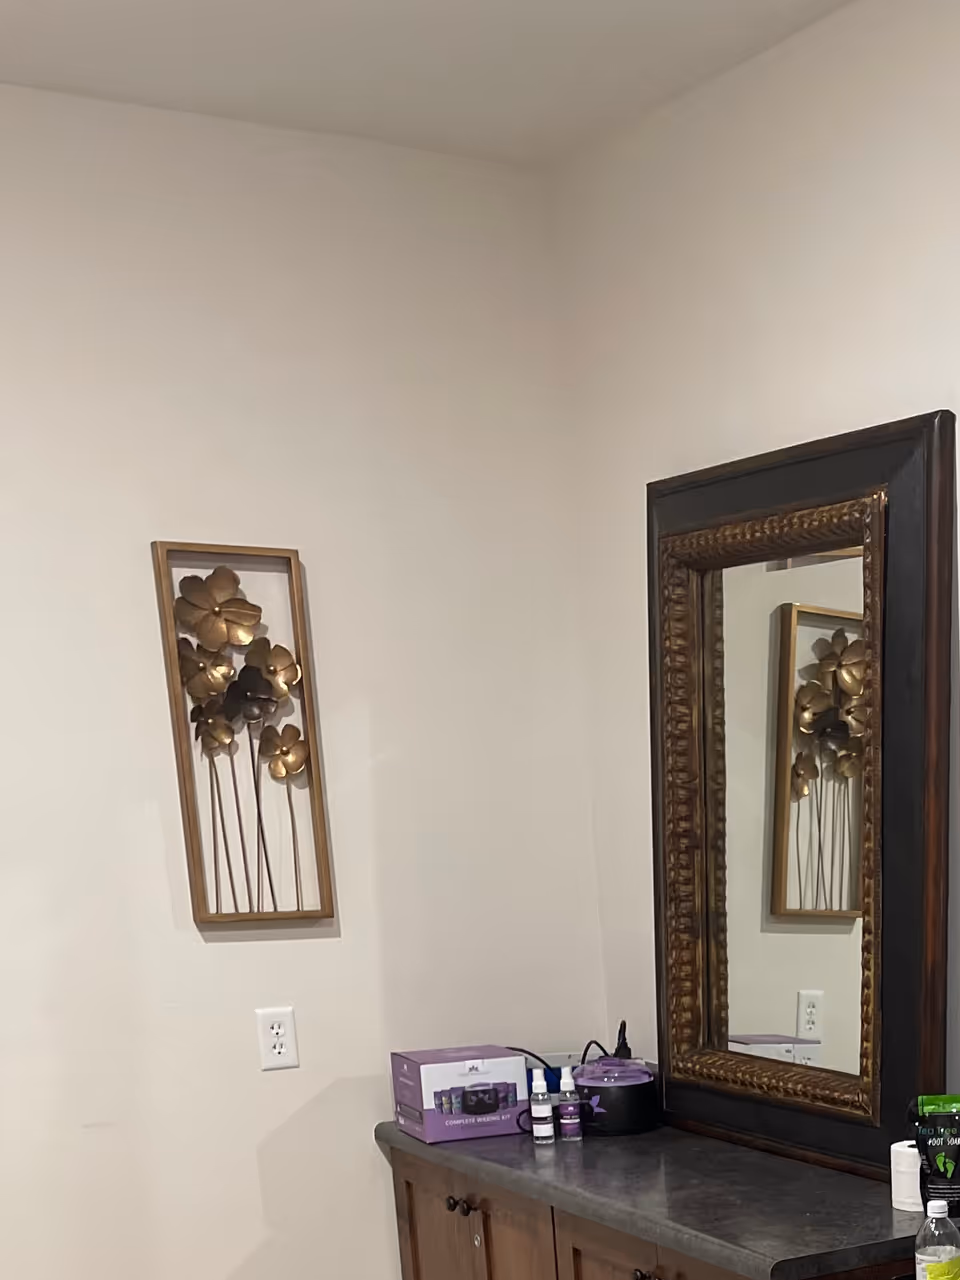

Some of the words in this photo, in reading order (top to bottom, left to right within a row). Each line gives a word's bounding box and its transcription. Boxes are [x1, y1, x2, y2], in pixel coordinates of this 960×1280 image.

[445, 1117, 475, 1126] COMPLETE
[918, 1125, 934, 1135] Tea
[937, 1125, 958, 1135] Tree
